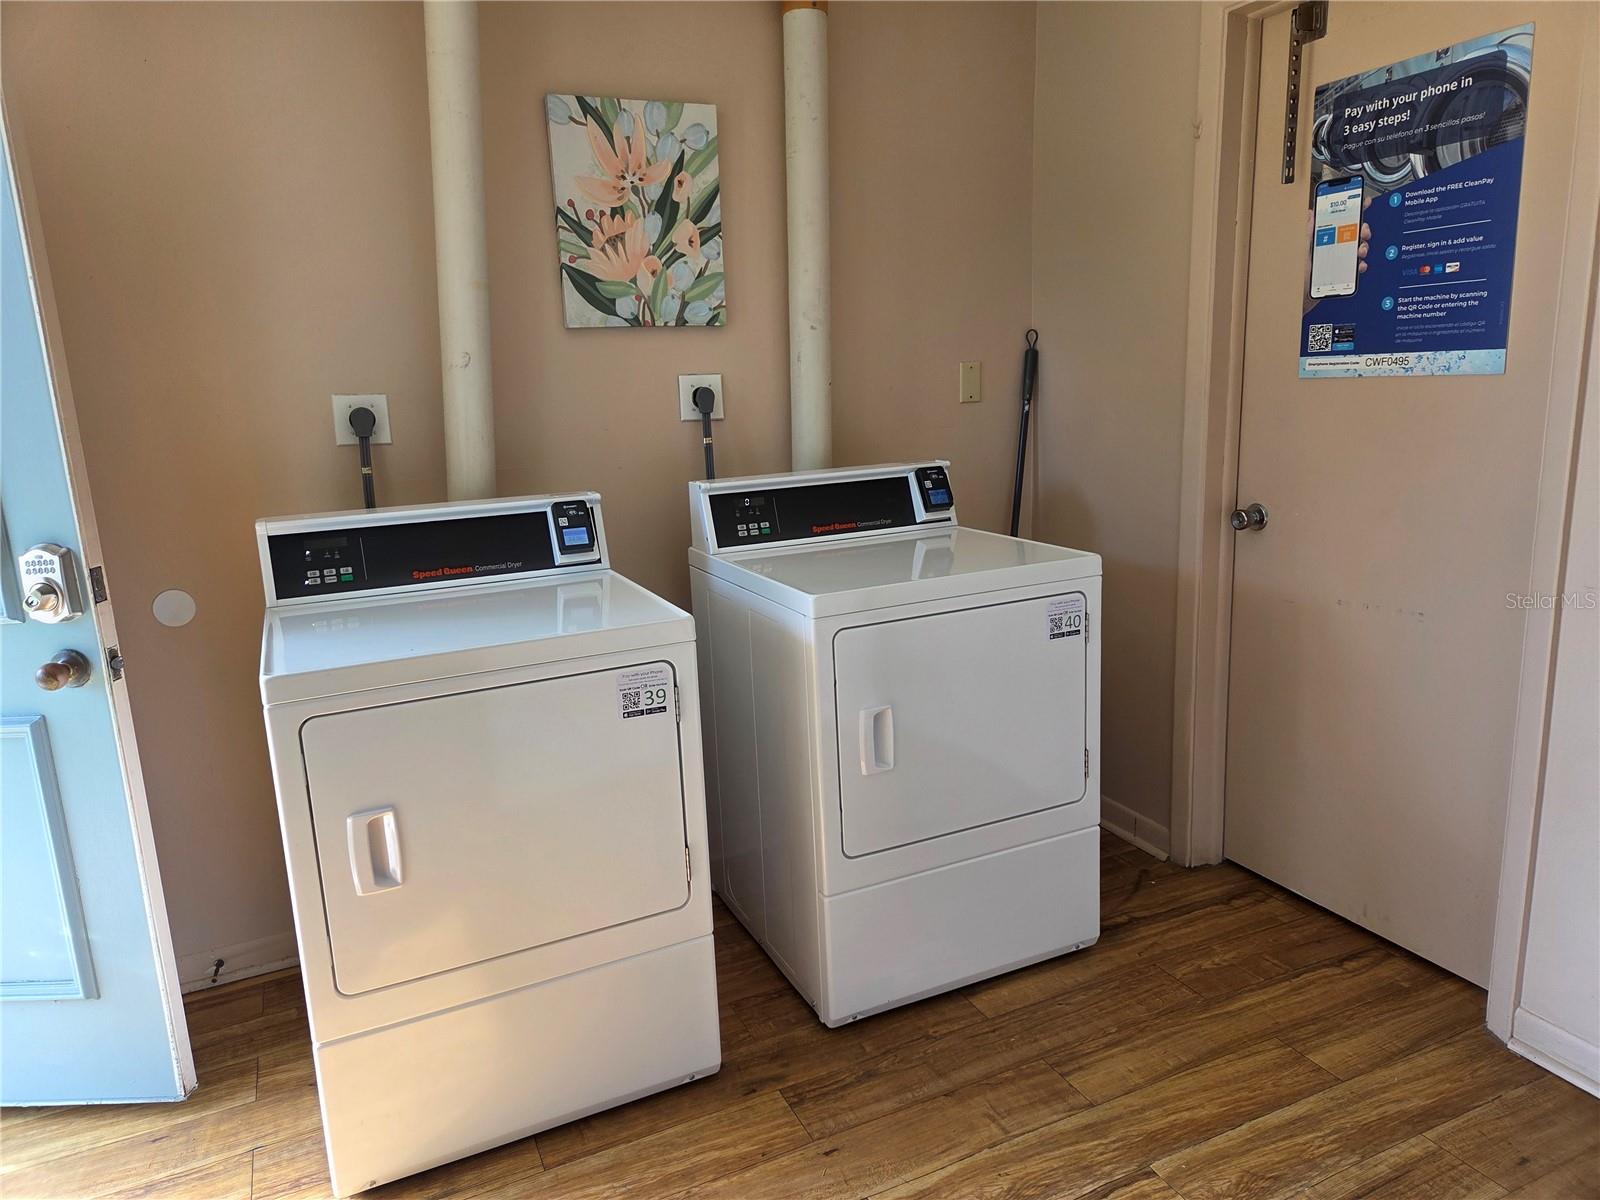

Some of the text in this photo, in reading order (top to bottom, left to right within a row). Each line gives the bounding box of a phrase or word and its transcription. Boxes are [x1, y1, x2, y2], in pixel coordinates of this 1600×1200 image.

[1344, 76, 1473, 119] Pay with your phone in
[1343, 110, 1411, 136] 3 easy steps!
[1424, 124, 1430, 132] 3
[1430, 118, 1460, 131] sencillos
[1405, 187, 1435, 198] Download
[1447, 182, 1463, 191] FREE
[1464, 177, 1494, 188] CleanPay
[1330, 200, 1347, 208] $10.00
[1404, 196, 1439, 207] Mobile App
[1401, 243, 1426, 252] Register,
[1427, 240, 1440, 249] sign
[1466, 235, 1484, 243] value
[1423, 293, 1450, 301] machine
[1450, 292, 1459, 300] by
[1459, 290, 1488, 299] scanning
[1441, 301, 1467, 309] entering
[1397, 312, 1422, 320] machine
[1365, 356, 1410, 367] CWF0495
[812, 525, 834, 533] Speed
[412, 561, 522, 579] Speed Queen Commercial Dryer
[1065, 614, 1081, 629] 40
[644, 688, 666, 706] 39
